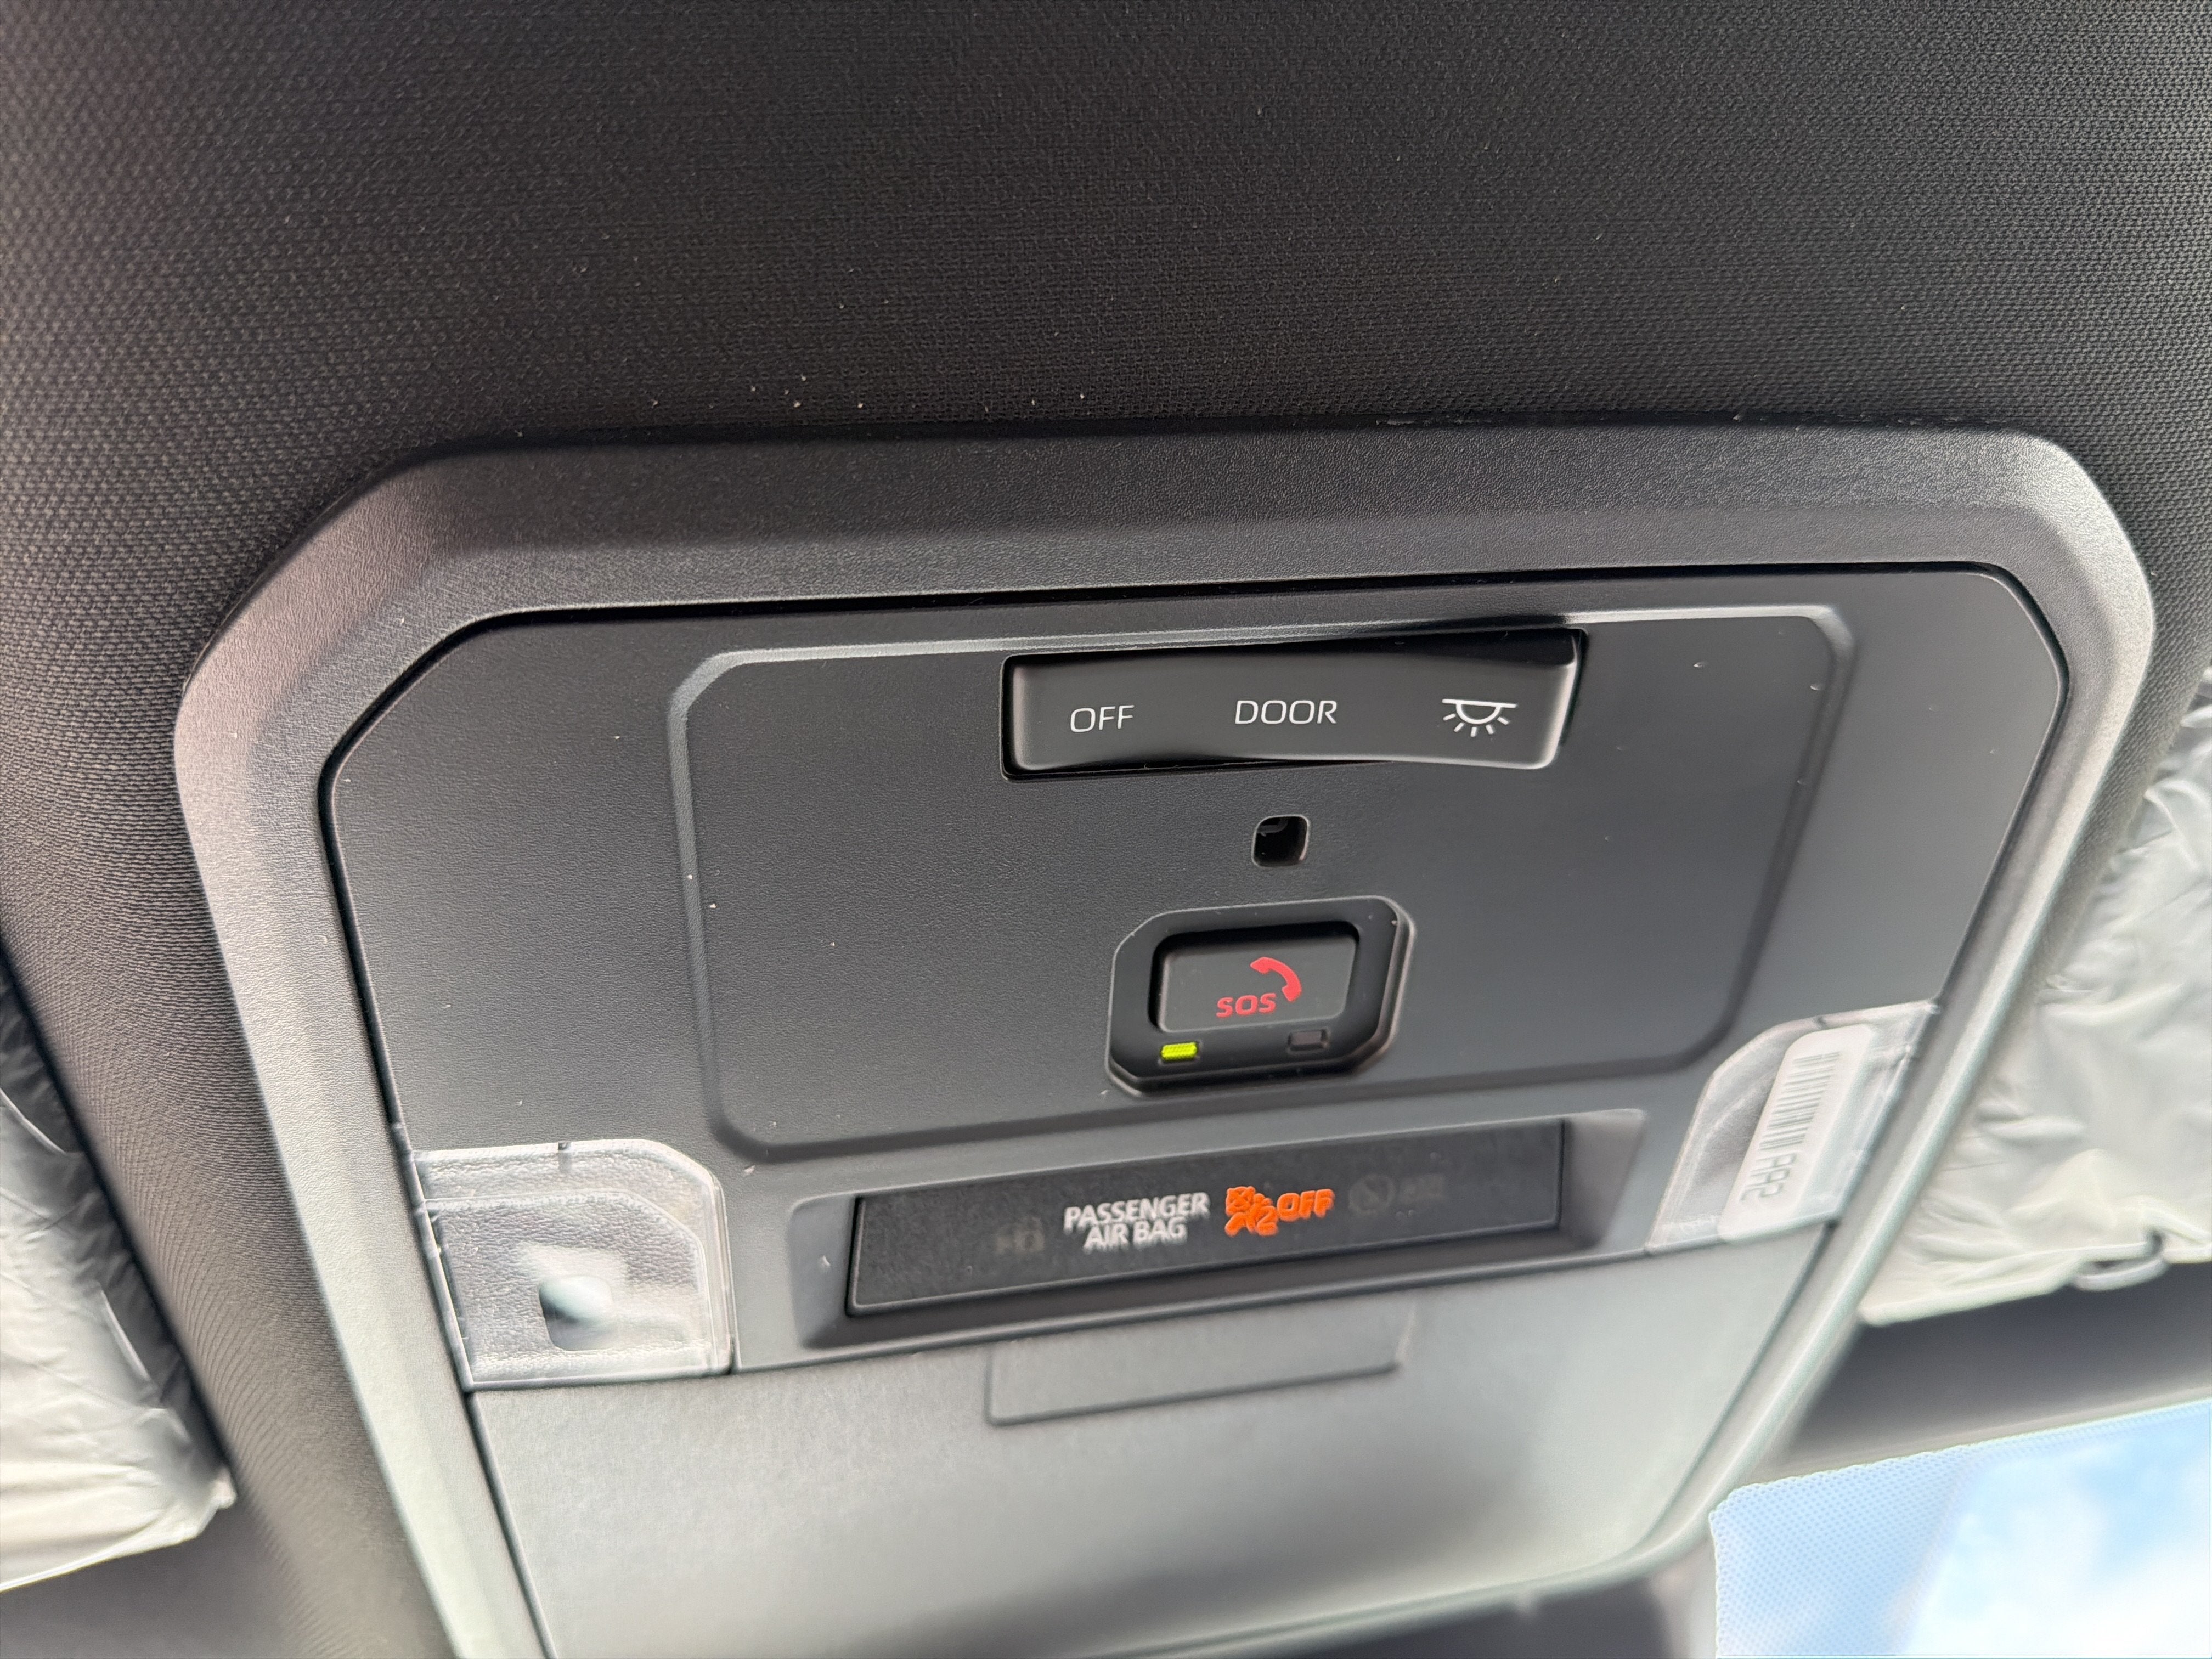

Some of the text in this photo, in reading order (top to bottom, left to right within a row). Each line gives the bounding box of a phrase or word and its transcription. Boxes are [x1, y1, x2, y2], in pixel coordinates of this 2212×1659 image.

[1069, 704, 1135, 733] OFF
[1234, 699, 1338, 725] DOOR
[1215, 992, 1277, 1018] SOS
[1063, 1192, 1210, 1234] PASSENGER
[1277, 1188, 1335, 1222] OFF
[1082, 1216, 1188, 1255] AIR BAG
